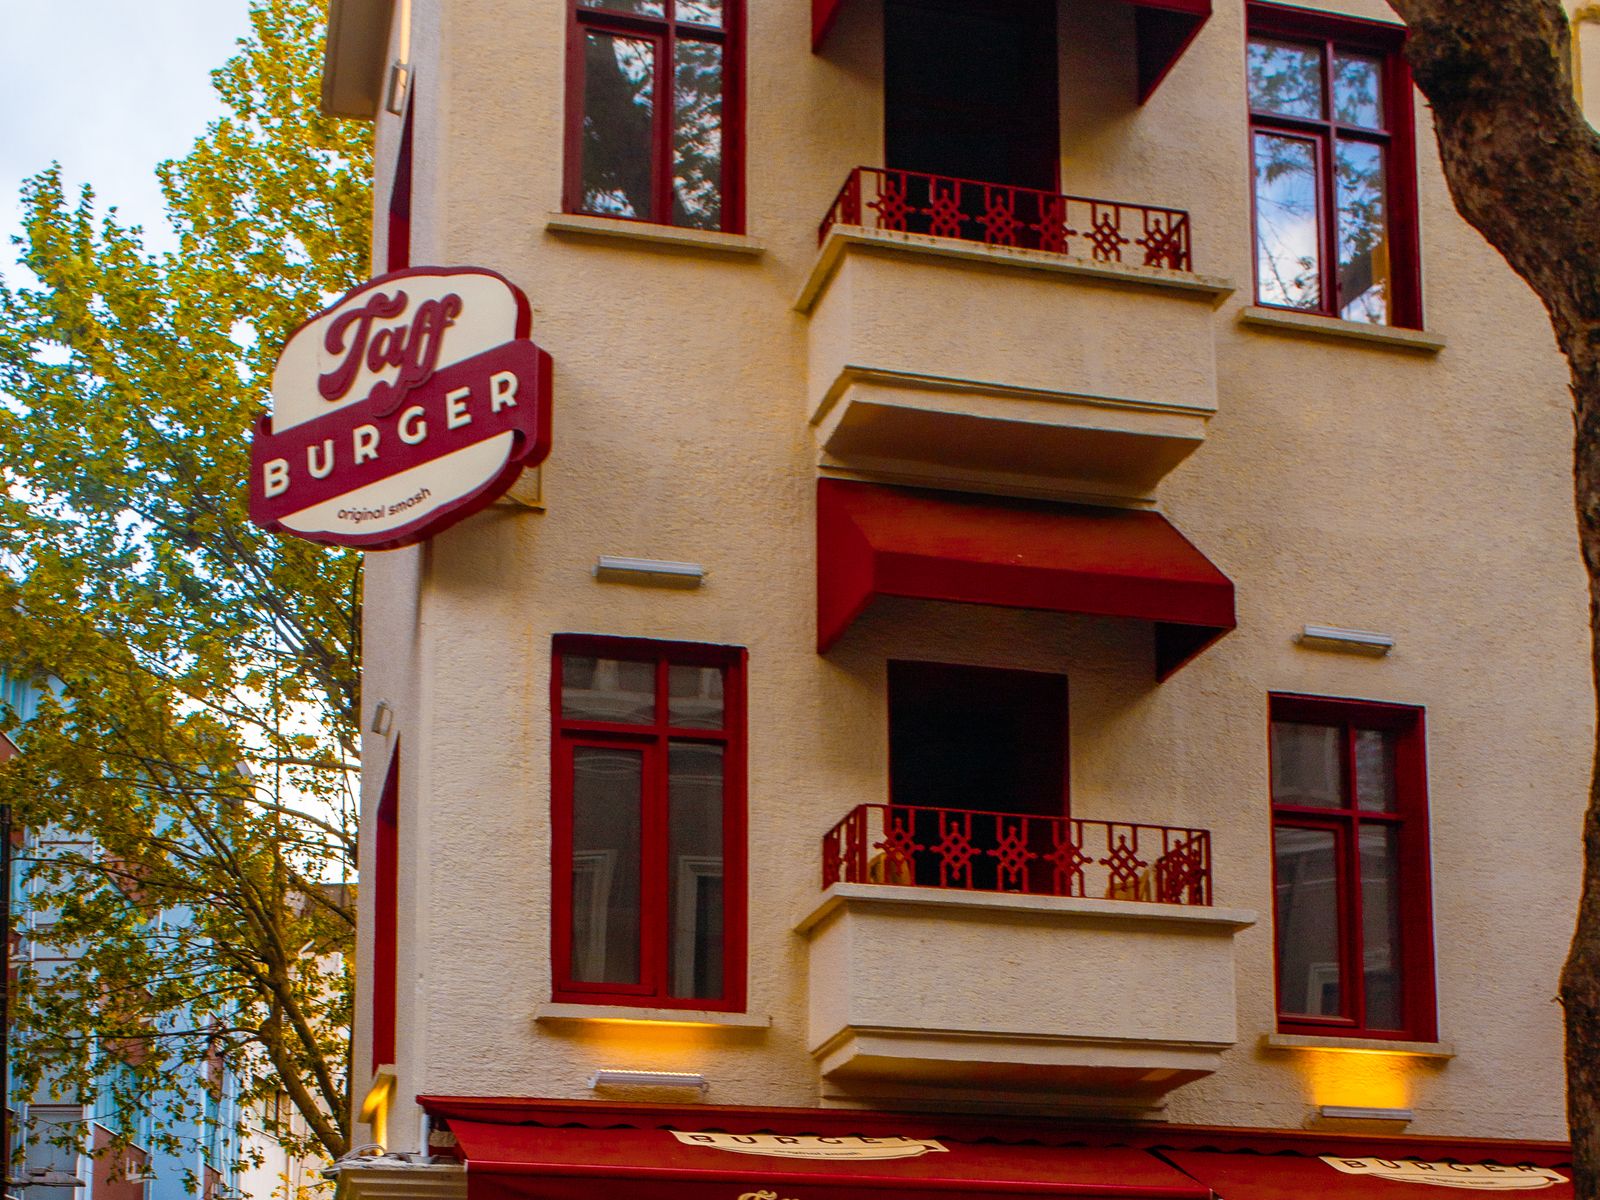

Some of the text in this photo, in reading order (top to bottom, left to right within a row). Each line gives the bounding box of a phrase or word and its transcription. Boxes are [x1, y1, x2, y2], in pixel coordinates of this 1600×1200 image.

[318, 290, 463, 417] Taff
[263, 371, 519, 499] BURGER
[337, 488, 431, 524] original smash
